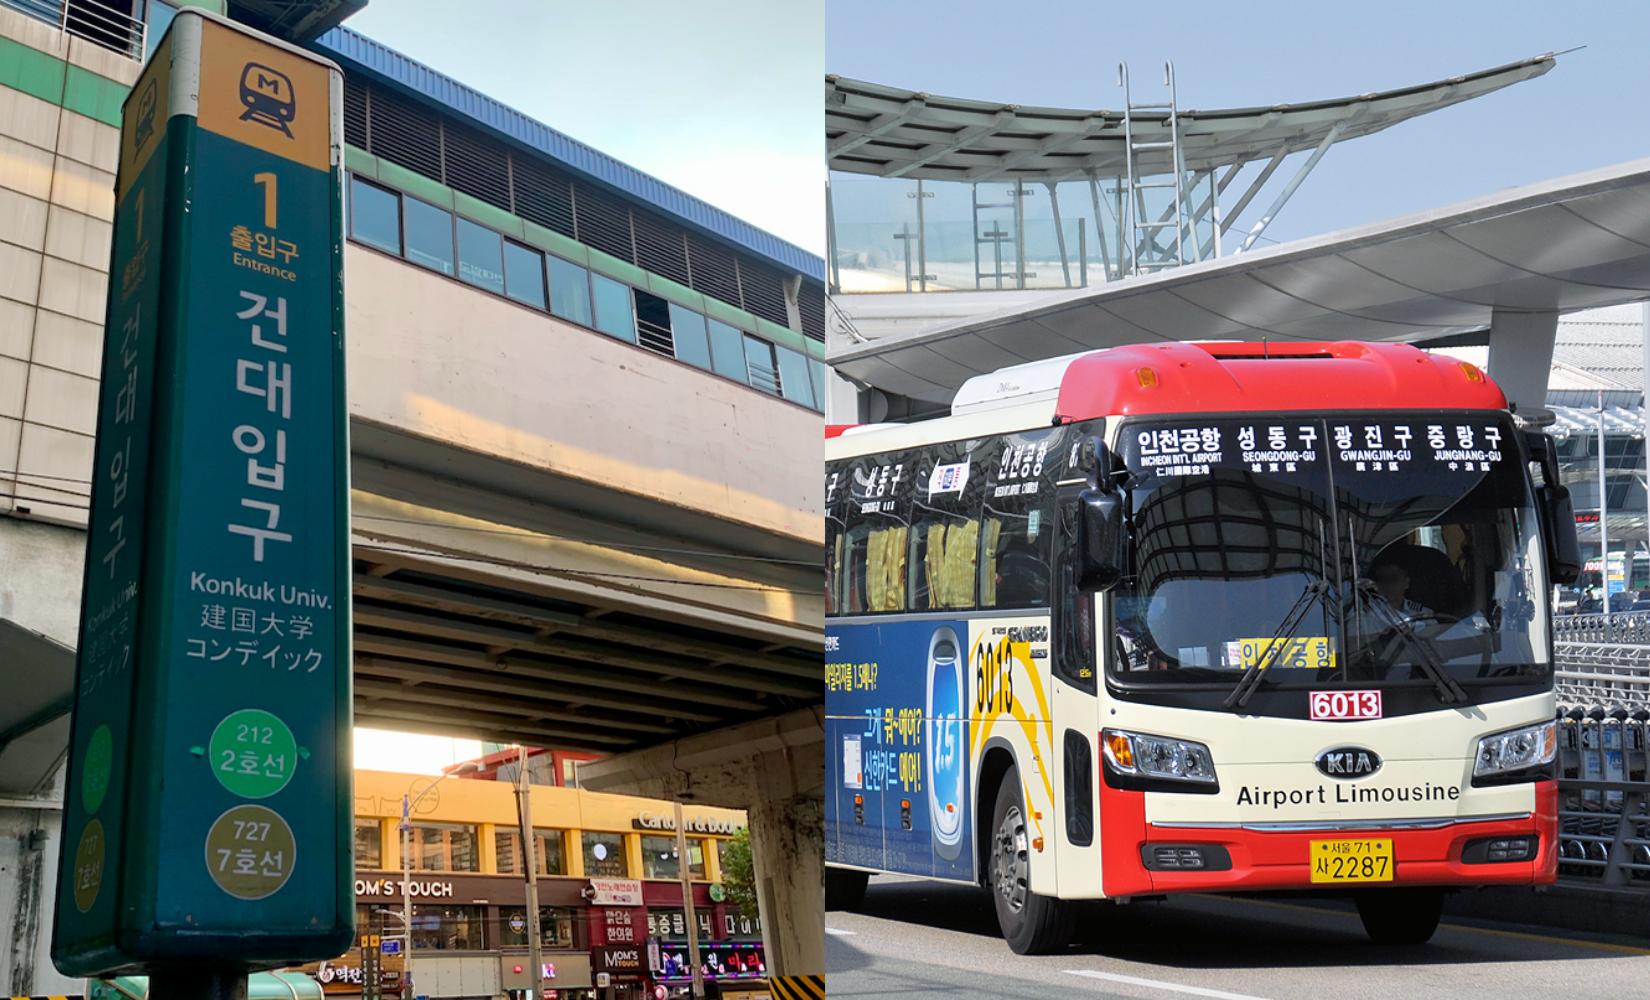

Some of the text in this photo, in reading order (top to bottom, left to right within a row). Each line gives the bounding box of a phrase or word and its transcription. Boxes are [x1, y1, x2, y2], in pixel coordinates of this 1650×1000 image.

[254, 171, 277, 230] 1
[230, 225, 299, 264] 출입구
[233, 252, 297, 282] Entrance
[227, 289, 293, 562] 건대입구
[1138, 424, 1502, 455] 인천공항 성동구 광진구 중랑구
[998, 440, 1048, 481] 인천공항
[1140, 454, 1172, 467] INCHEON
[1192, 452, 1223, 463] AIRPORT
[1242, 450, 1316, 462] SEONGDONG-GU
[1340, 450, 1411, 461] GWANGJIN-GU
[1434, 450, 1502, 462] JUNGNANG-GU
[190, 570, 332, 610] Konkuk Univ.
[200, 603, 313, 640] 建国大学
[977, 641, 1013, 714] 6013
[1313, 692, 1380, 717] 6013
[236, 724, 274, 745] 212
[221, 749, 286, 779] 2호선
[864, 750, 898, 792] 신한카드
[1327, 752, 1373, 774] KIA
[1236, 781, 1462, 809] Airport Limousine
[232, 821, 271, 842] 727
[639, 810, 693, 832] Carton
[1332, 841, 1371, 854] 서울 71
[217, 849, 284, 878] 7호선
[354, 879, 453, 897] OM'S TOUCH
[604, 950, 639, 968] MOM'S
